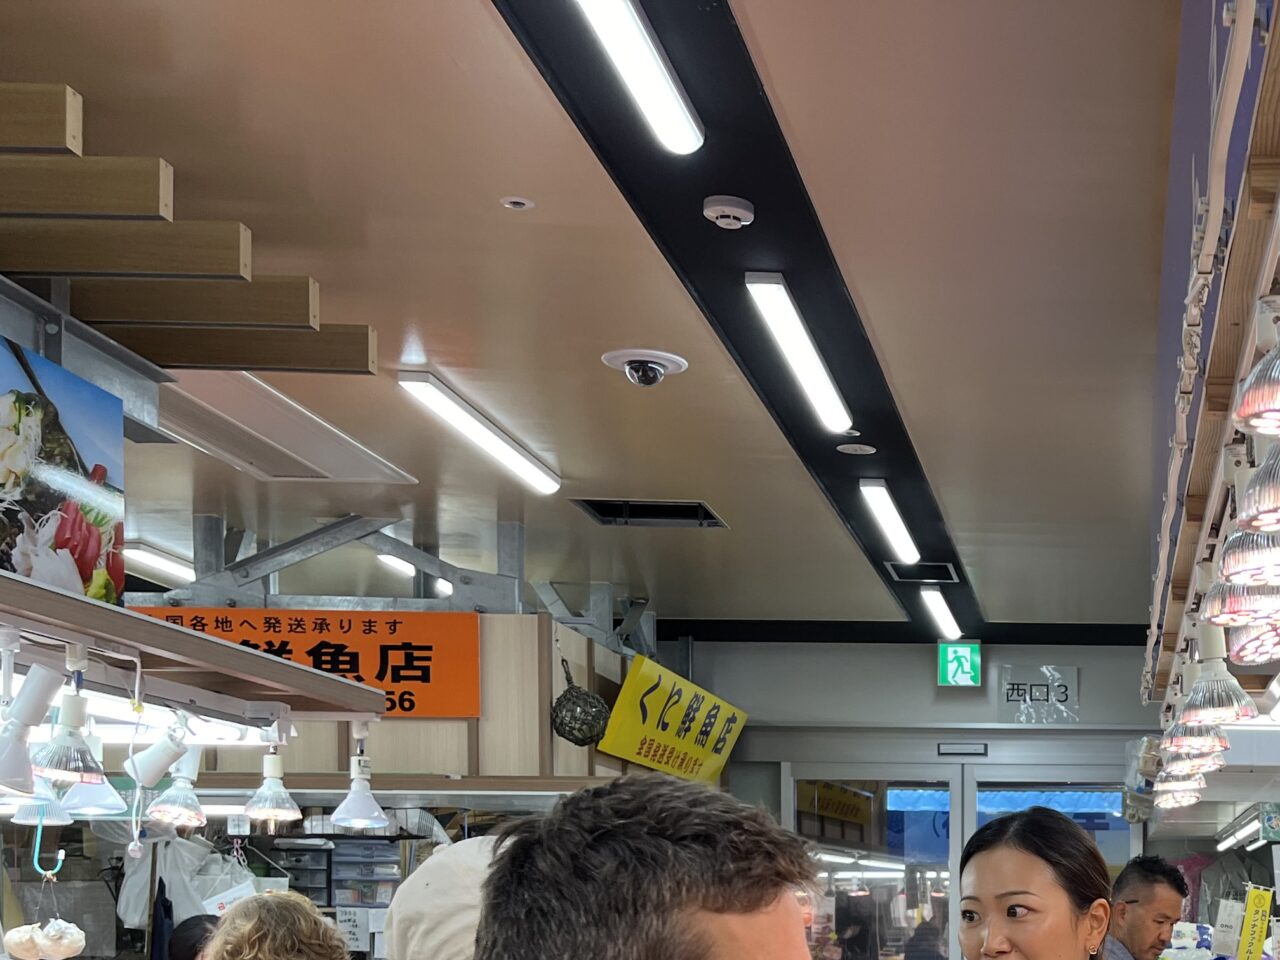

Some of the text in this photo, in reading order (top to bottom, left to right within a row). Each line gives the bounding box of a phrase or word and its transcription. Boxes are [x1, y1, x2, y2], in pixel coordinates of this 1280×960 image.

[146, 613, 404, 635] 国各地へ発送承ります
[1006, 683, 1070, 703] 西口3
[639, 673, 738, 756] くに鮮魚店
